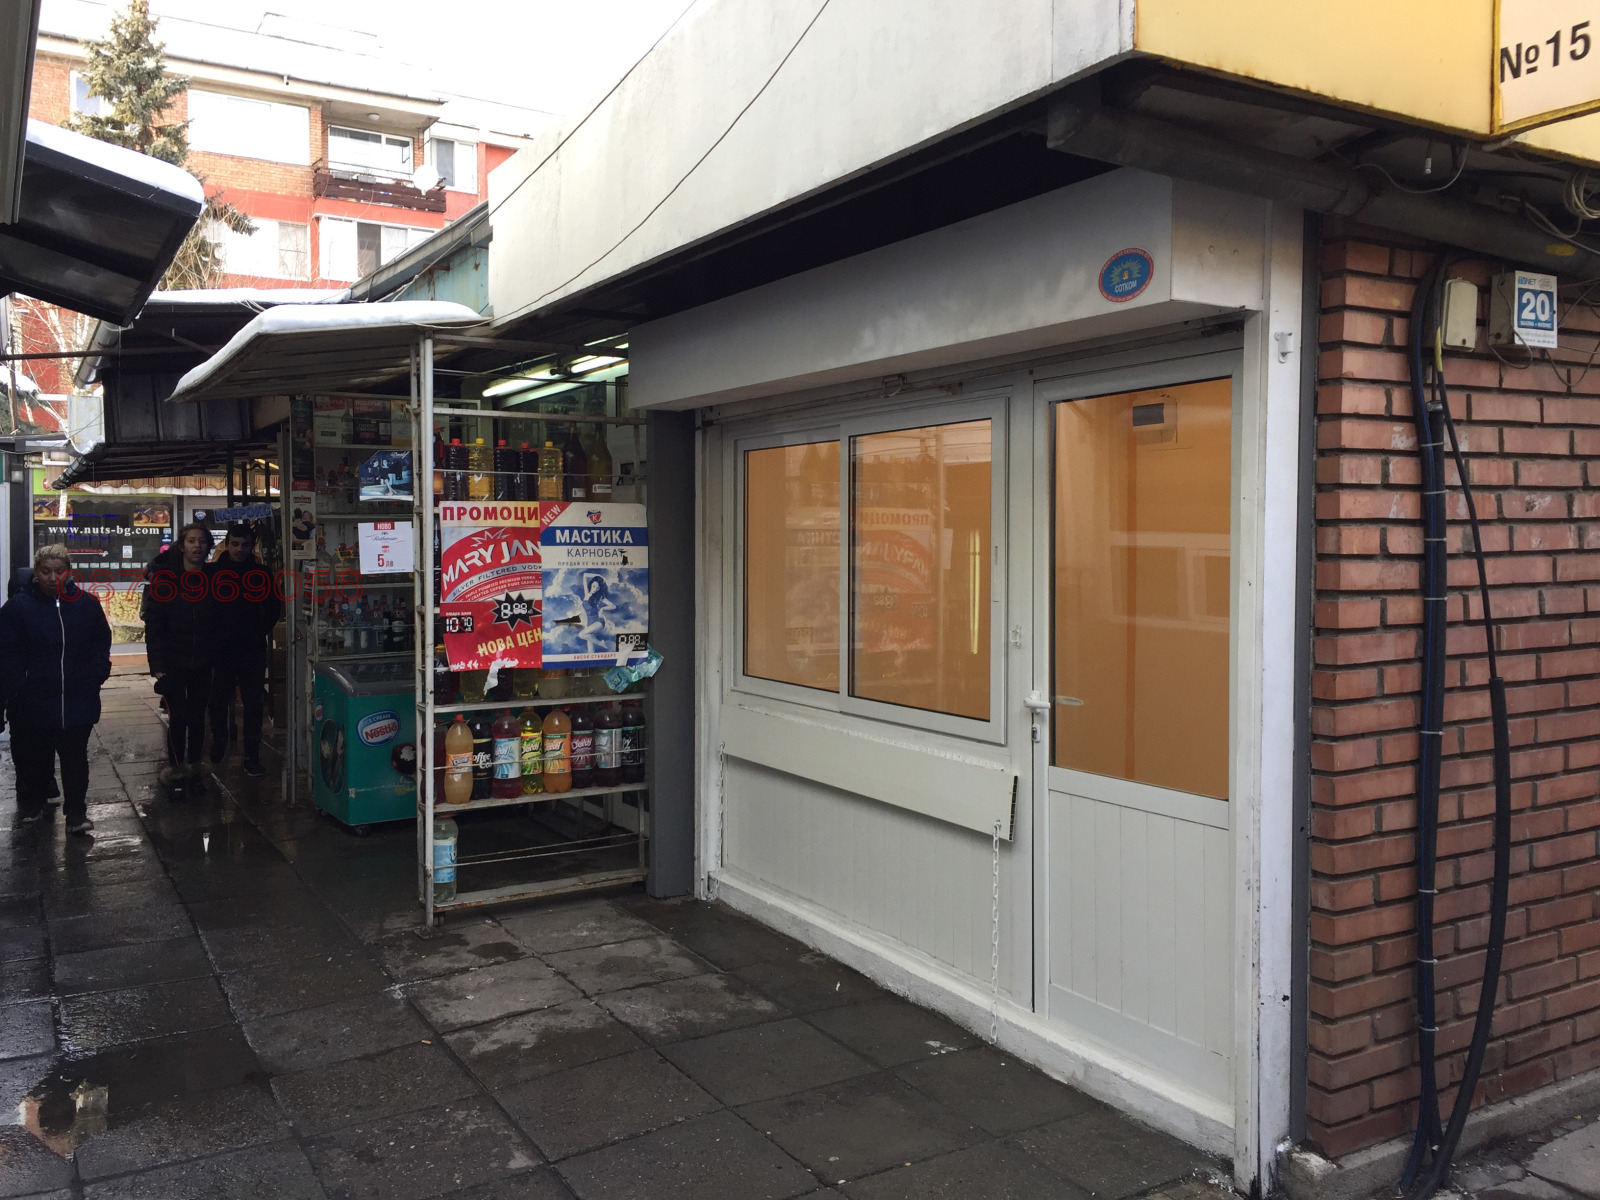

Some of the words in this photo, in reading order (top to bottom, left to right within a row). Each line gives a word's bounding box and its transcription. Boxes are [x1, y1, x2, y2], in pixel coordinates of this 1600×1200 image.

[1114, 280, 1138, 293] СОТКОМ
[1521, 291, 1550, 322] 20
[214, 504, 272, 522] КСЕРОКС
[541, 504, 561, 526] NEW
[48, 525, 160, 538] www.nuts-bg.com
[555, 529, 634, 545] МАСТИКА
[377, 554, 385, 567] 5
[567, 548, 626, 558] КАРНОБАТ
[442, 544, 496, 592] MARY
[452, 579, 475, 598] SILVER
[478, 566, 518, 582] FILTERED
[477, 635, 515, 658] НОВА
